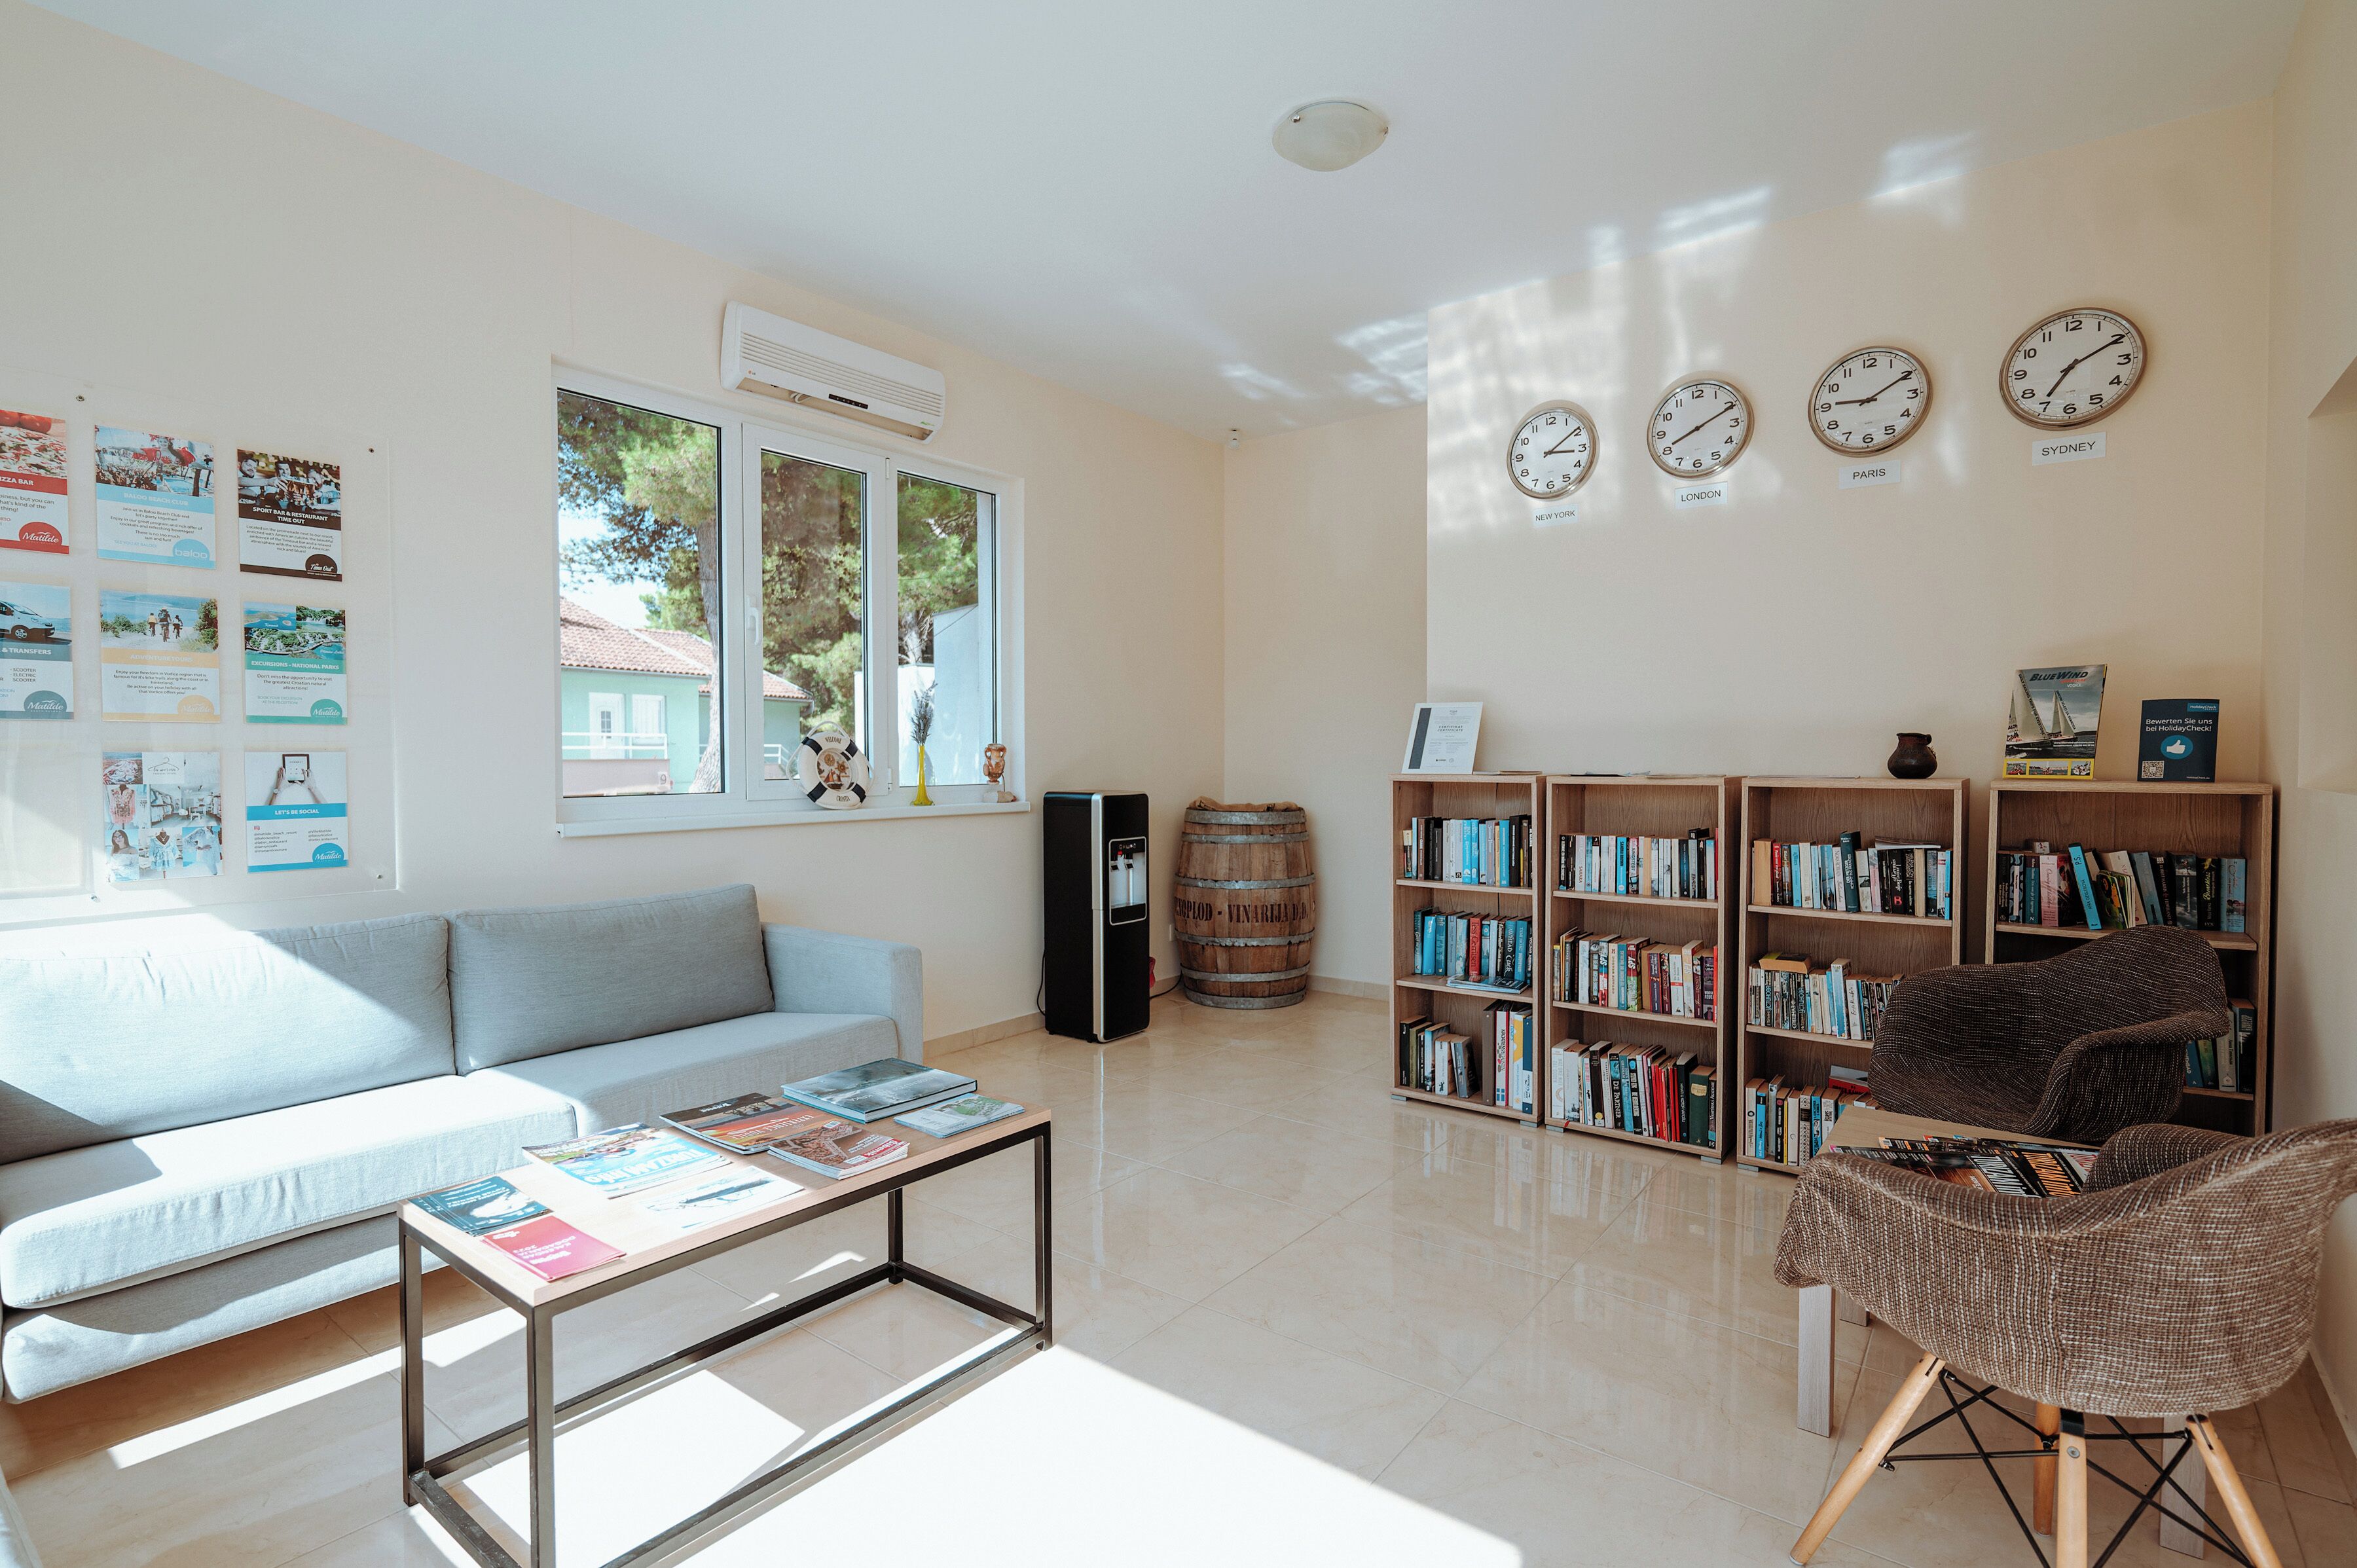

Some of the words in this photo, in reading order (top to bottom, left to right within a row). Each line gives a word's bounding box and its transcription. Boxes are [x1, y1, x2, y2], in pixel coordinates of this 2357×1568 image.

[2066, 320, 2083, 332] 12
[2098, 321, 2101, 331] 1
[2043, 331, 2051, 342] 11
[2111, 334, 2126, 345] 2
[2024, 348, 2037, 359] 10
[1863, 358, 1877, 369] 12
[1890, 359, 1892, 368] 1
[2117, 354, 2131, 365] 3
[1844, 368, 1851, 378] 11
[1901, 371, 1913, 380] 2
[2015, 370, 2027, 380] 9
[2109, 375, 2122, 386] 4
[1829, 384, 1839, 393] 10
[1692, 390, 1704, 399] 12
[1715, 390, 1717, 399] 1
[1907, 389, 1918, 399] 3
[2021, 389, 2035, 399] 8
[1676, 399, 1682, 408] 11
[2089, 393, 2103, 405] 5
[1725, 401, 1736, 410] 2
[1821, 403, 1831, 412] 9
[2039, 401, 2051, 412] 7
[2063, 403, 2077, 414] 6
[1663, 412, 1672, 422] 10
[1900, 409, 1911, 418] 4
[1546, 417, 1556, 426] 12
[1730, 418, 1740, 428] 3
[1827, 420, 1839, 429] 8
[1573, 428, 1582, 437] 2
[1884, 425, 1896, 435] 5
[1842, 432, 1852, 441] 7
[1863, 434, 1873, 443] 6
[1579, 444, 1586, 452] 3
[2042, 441, 2095, 456] SYDNEY
[1711, 451, 1721, 460] 5
[1675, 457, 1684, 466] 7
[1693, 460, 1702, 468] 6
[1562, 474, 1571, 483] 5
[1854, 469, 1886, 479] PARIS
[1681, 490, 1721, 501] LONDON
[291, 513, 328, 521] RESTAURANT
[22, 532, 59, 543] Matilde
[175, 549, 208, 558] baloo
[27, 701, 64, 710] Matilde
[314, 707, 340, 716] Matilde
[315, 851, 341, 860] Matilde
[1894, 896, 1902, 905] B
[1228, 903, 1288, 923] VINARIJA
[1292, 902, 1308, 921] D.D.
[1613, 1081, 1619, 1089] DE
[1971, 1156, 2023, 1186] TURIZAM
[2022, 1152, 2071, 1182] TURIZAM
